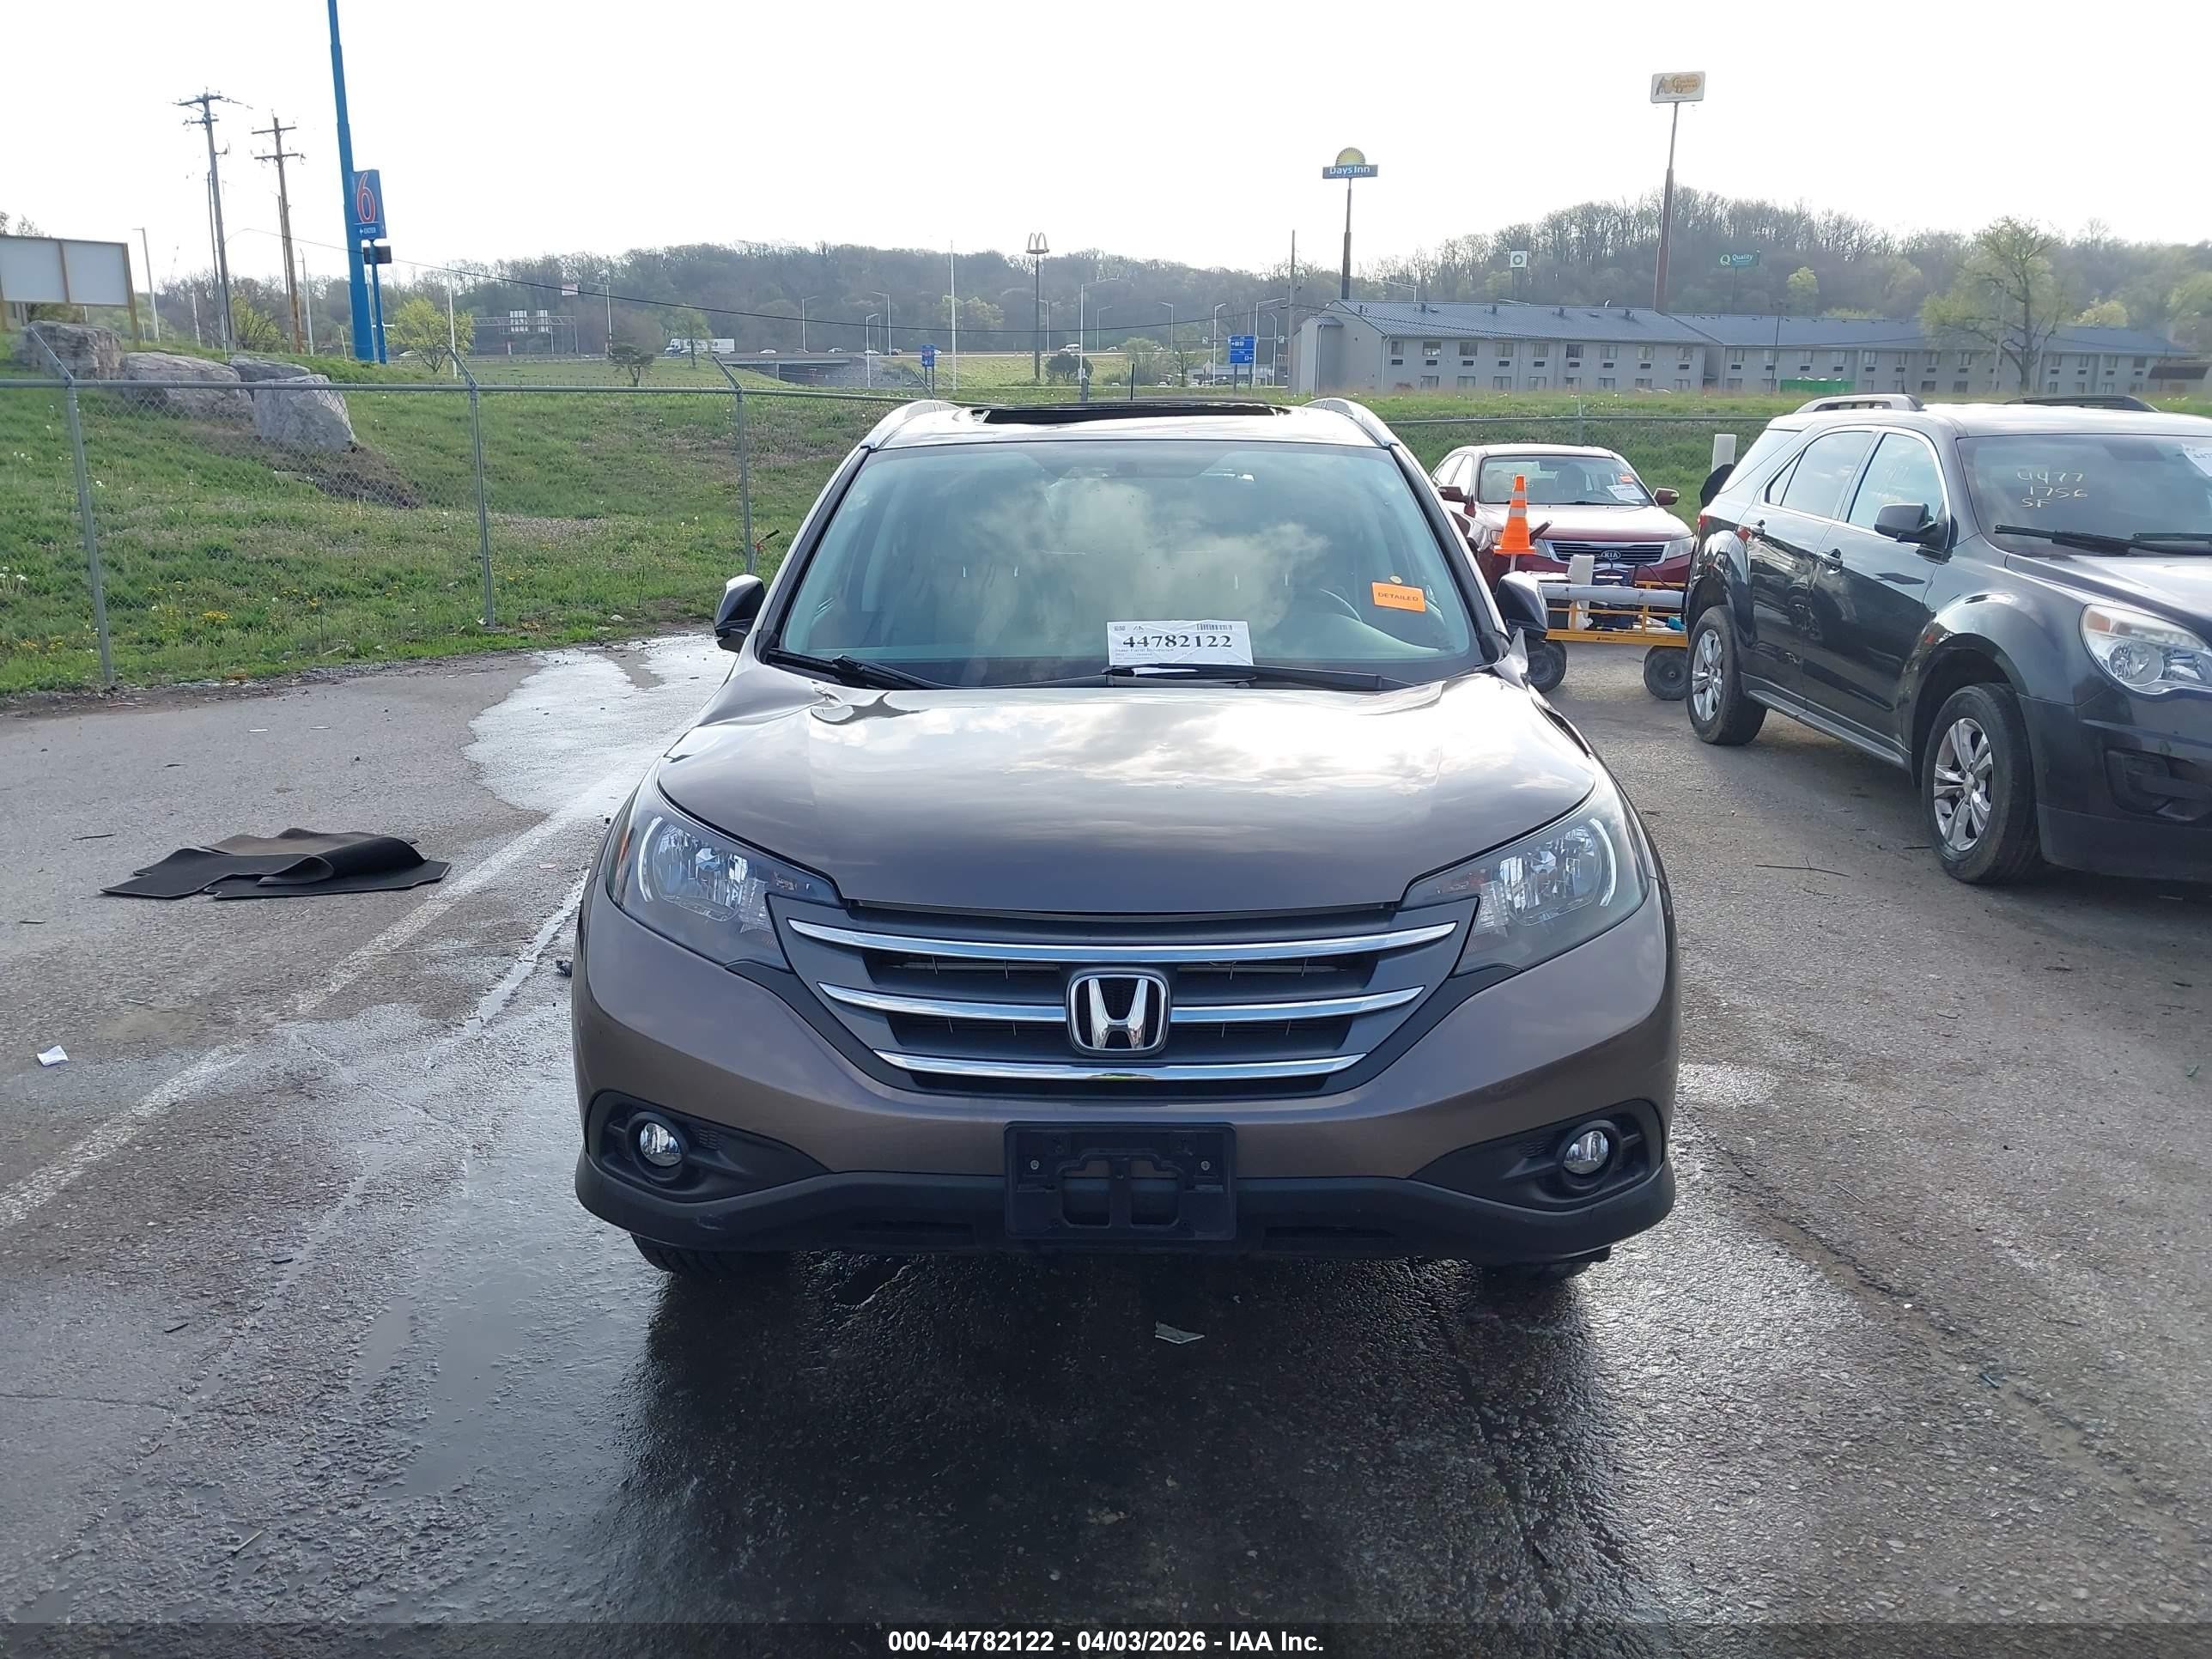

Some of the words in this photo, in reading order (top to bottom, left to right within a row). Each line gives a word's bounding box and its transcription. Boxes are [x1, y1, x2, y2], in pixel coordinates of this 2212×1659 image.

[1329, 166, 1353, 174] Days
[356, 172, 376, 223] 6
[1732, 253, 1753, 263] Quality
[2017, 471, 2083, 483] 4477
[2030, 486, 2088, 498] 1756
[2021, 498, 2051, 507] SF
[1377, 592, 1419, 602] DETAILED
[1122, 635, 1232, 647] 44782122
